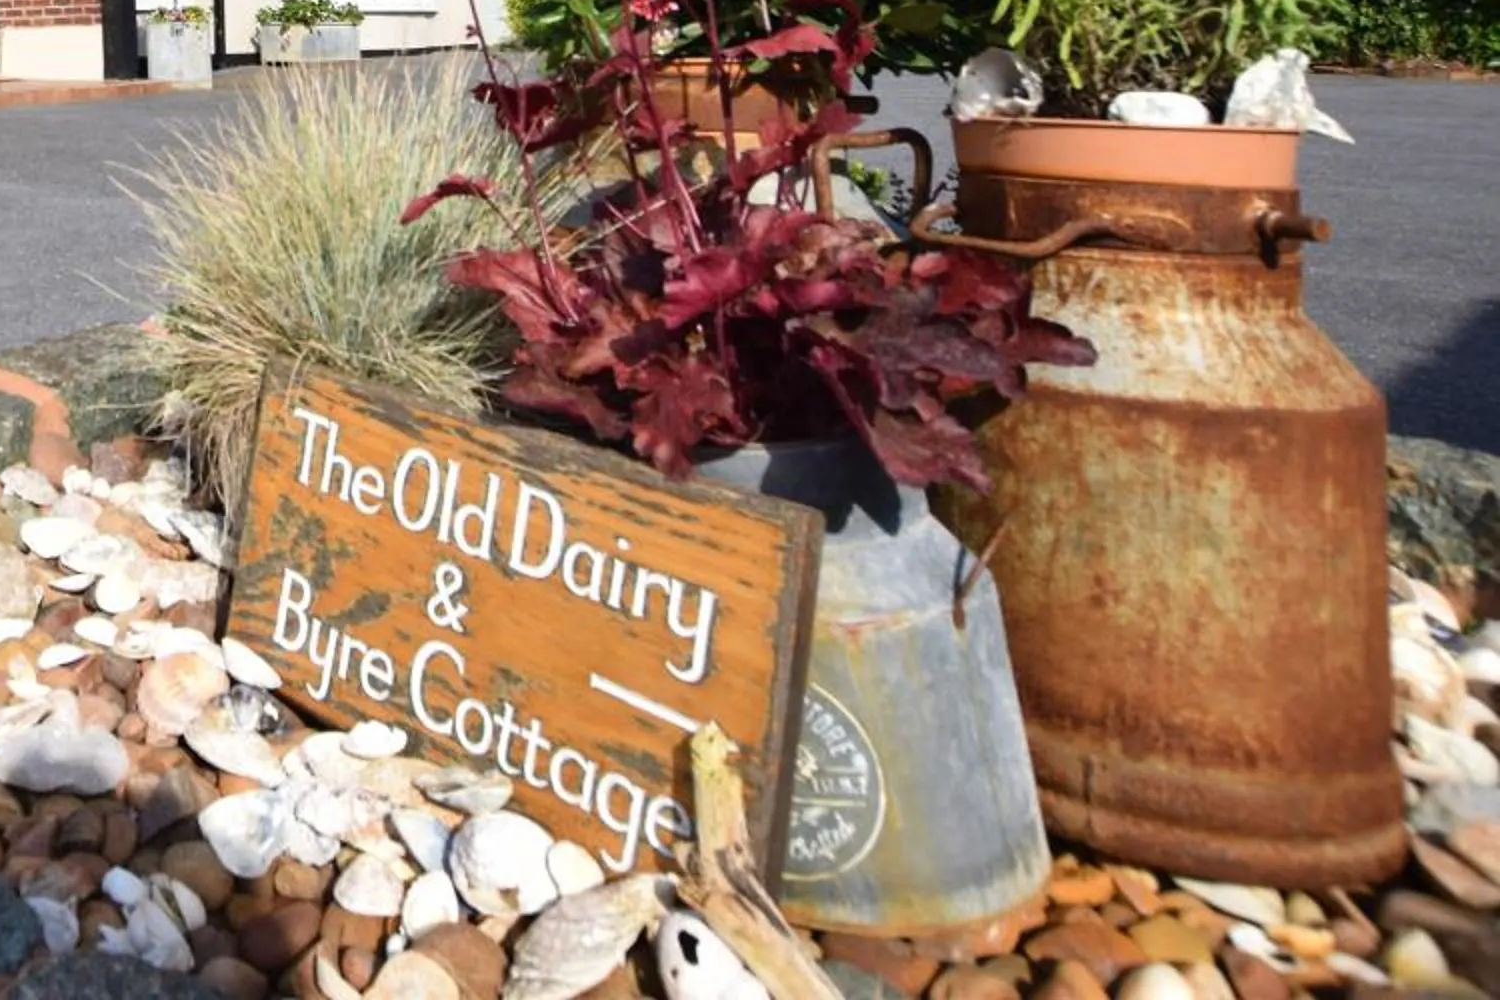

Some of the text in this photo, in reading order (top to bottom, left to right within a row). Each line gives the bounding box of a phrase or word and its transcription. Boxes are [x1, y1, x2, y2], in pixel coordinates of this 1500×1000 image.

[293, 407, 718, 683] The Old Dairy
[427, 562, 469, 633] &
[272, 567, 693, 873] Byre Cottage
